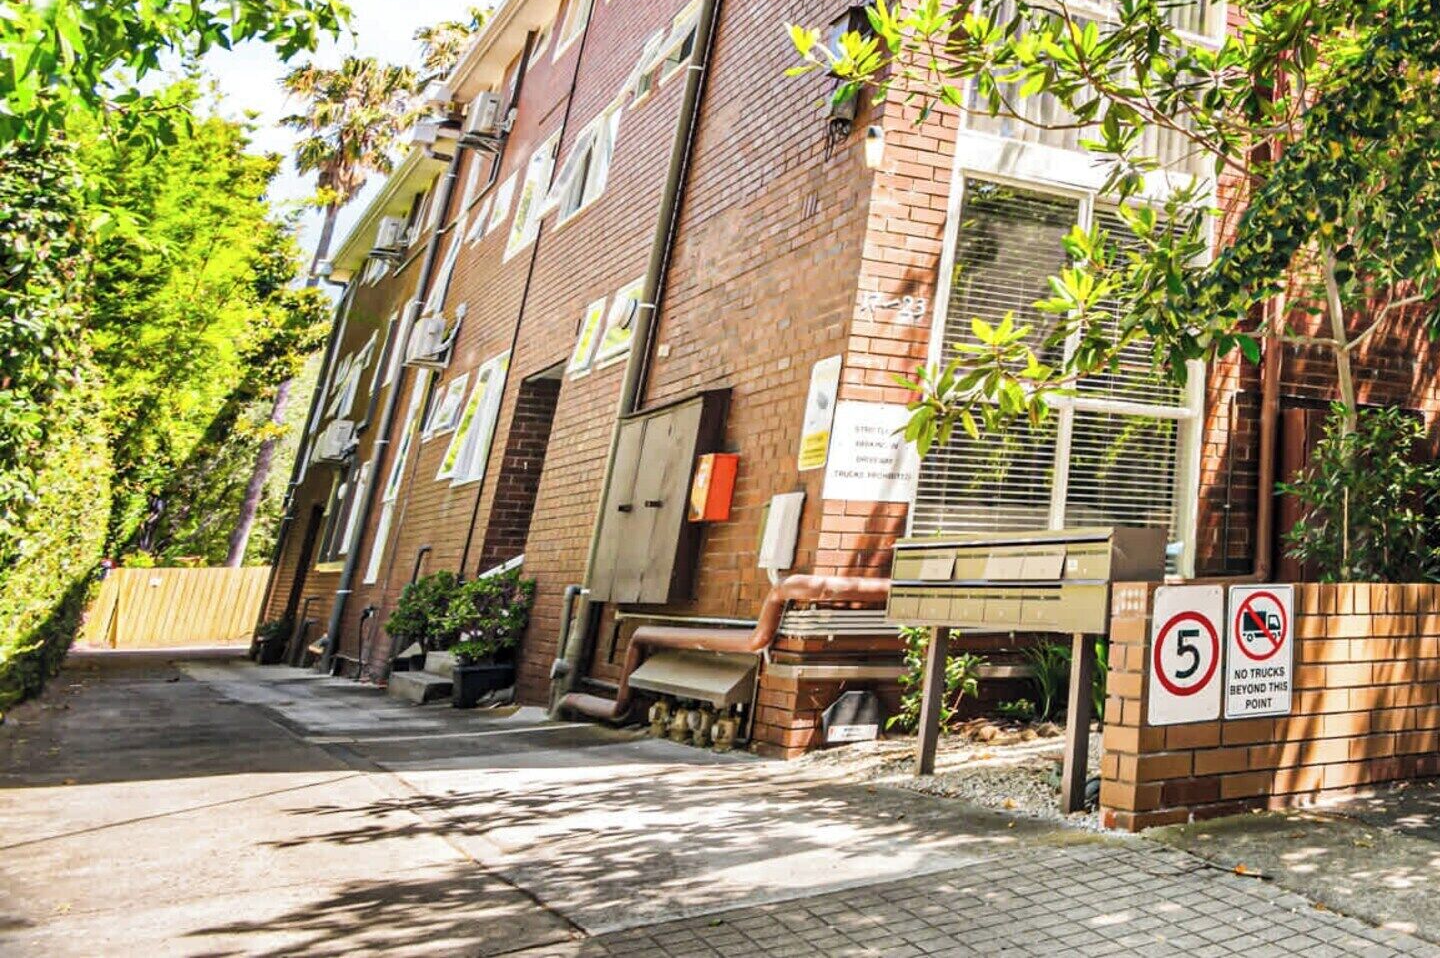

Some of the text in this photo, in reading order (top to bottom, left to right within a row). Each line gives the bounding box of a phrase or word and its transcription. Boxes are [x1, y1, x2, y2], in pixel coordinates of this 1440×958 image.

[1175, 629, 1201, 680] 5
[1234, 666, 1286, 680] NO TRUCKS
[1229, 680, 1288, 695] BEYOND THIS
[1245, 697, 1273, 710] POINT
